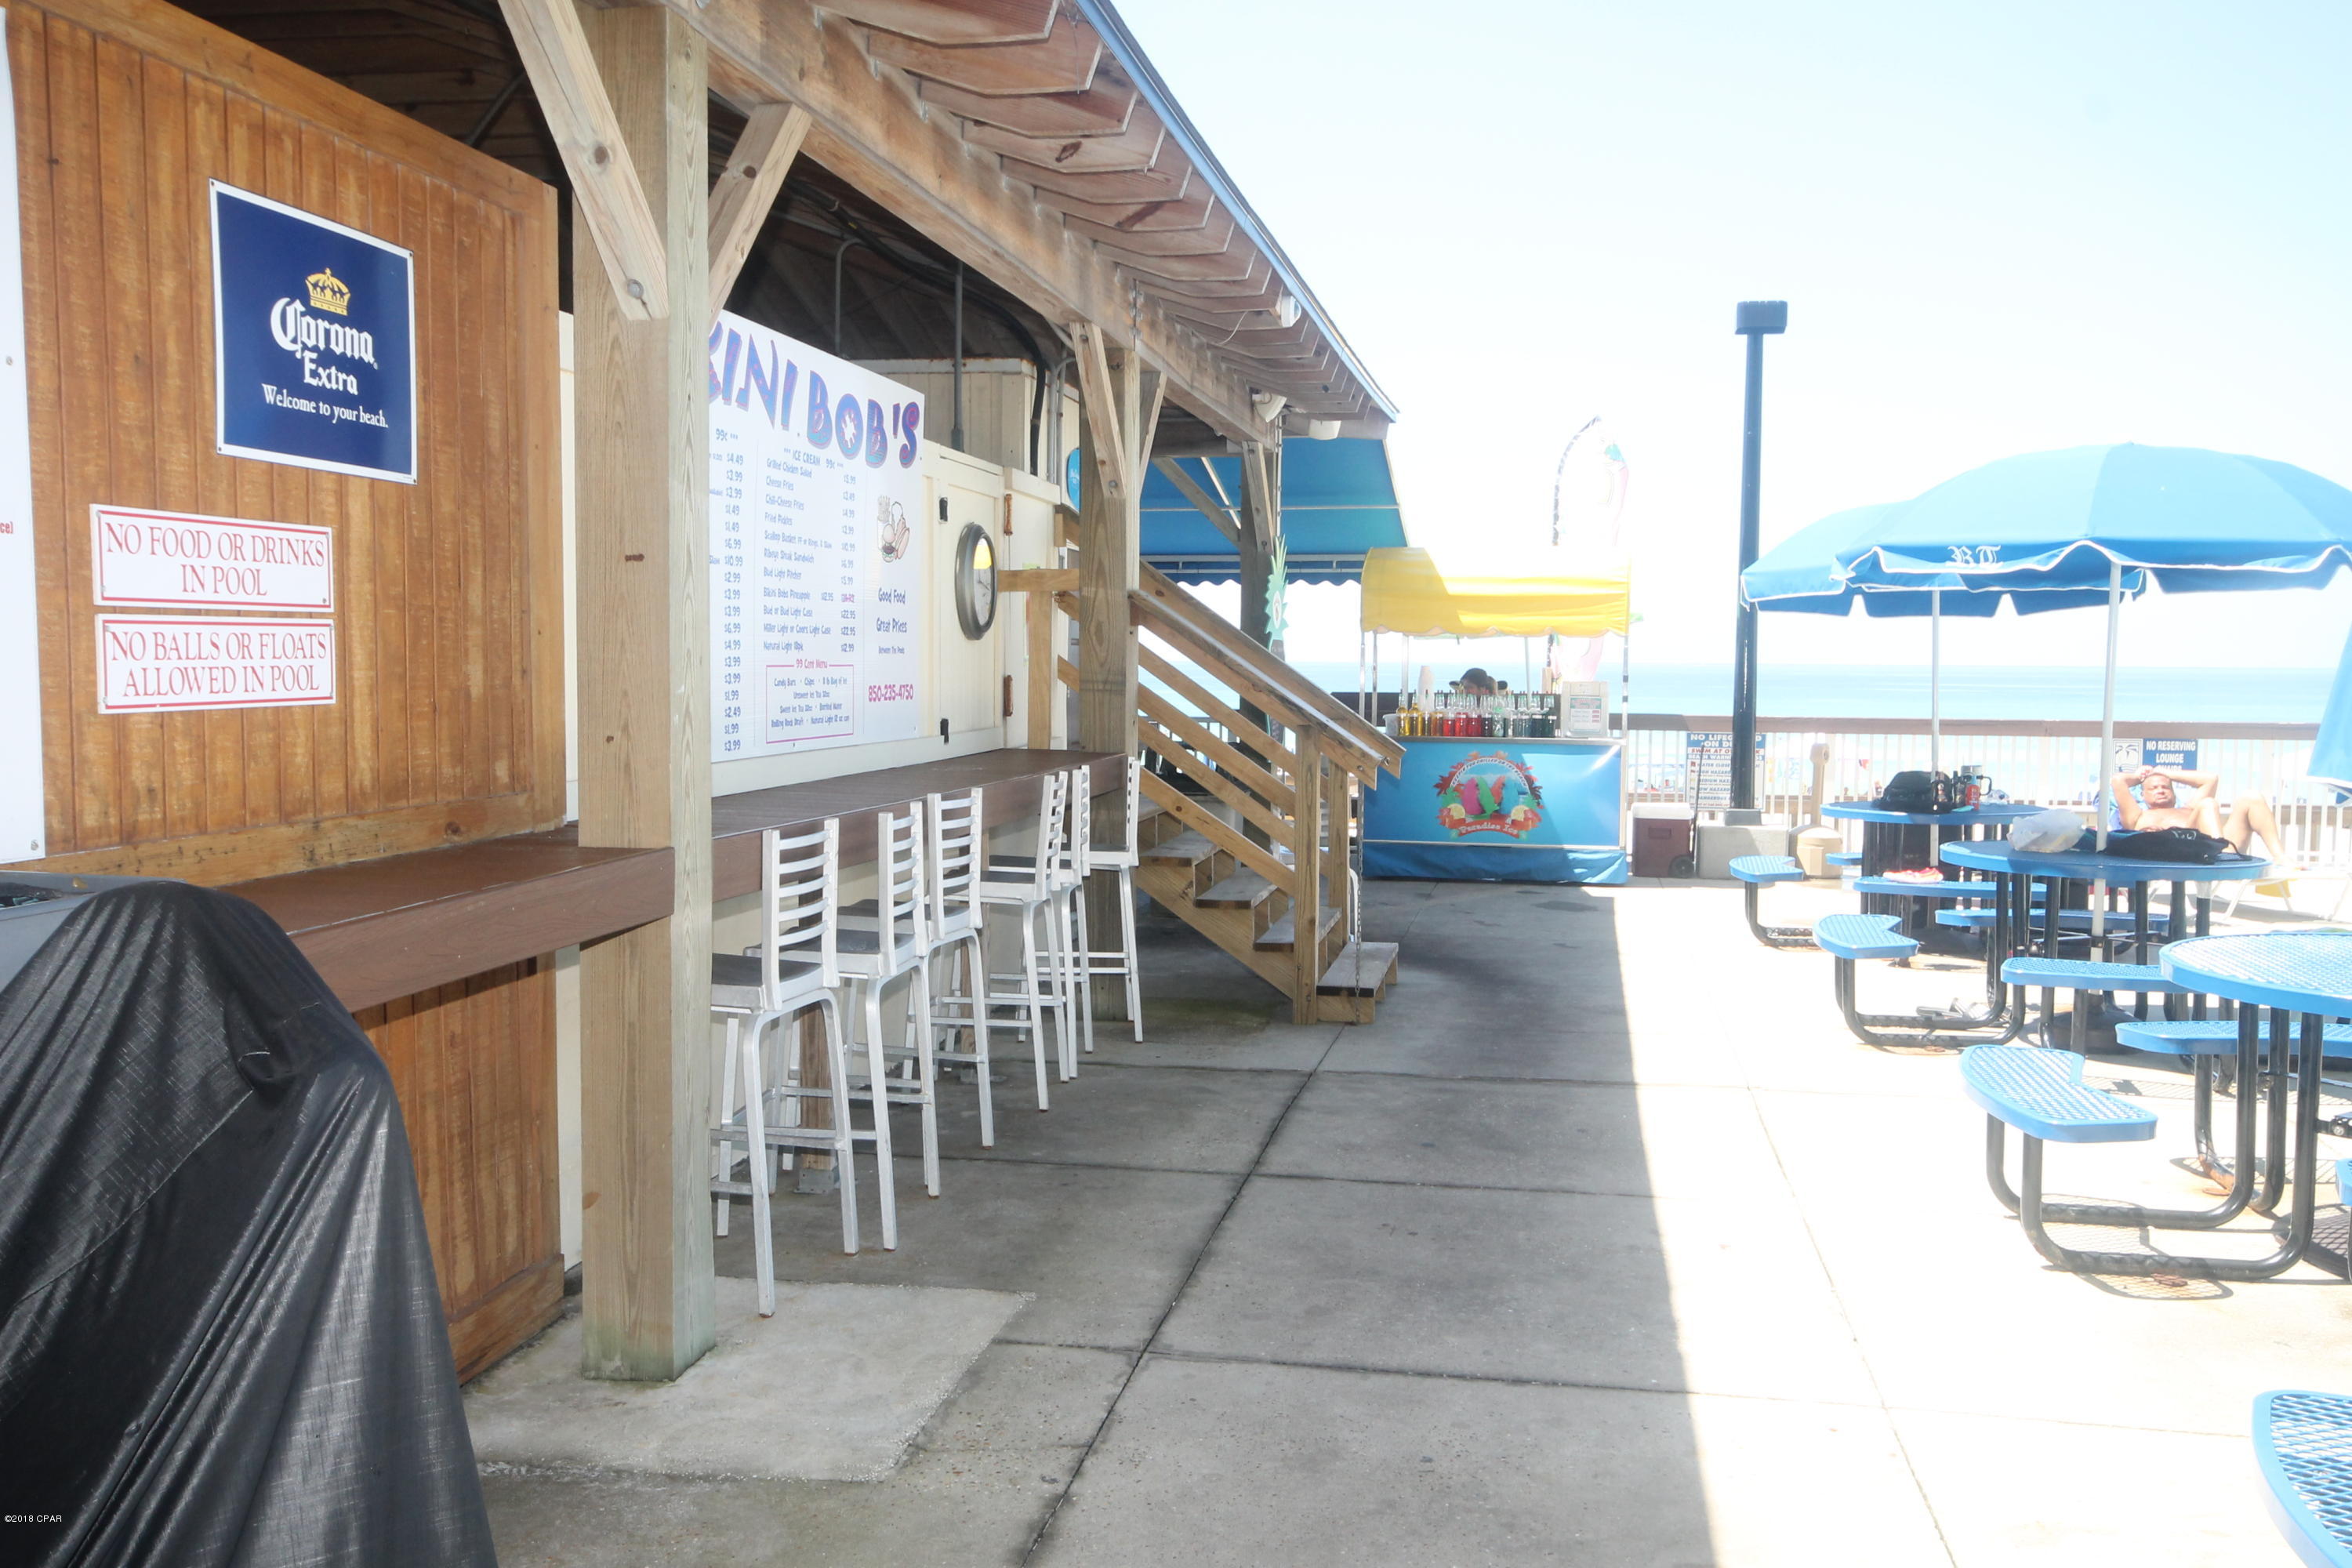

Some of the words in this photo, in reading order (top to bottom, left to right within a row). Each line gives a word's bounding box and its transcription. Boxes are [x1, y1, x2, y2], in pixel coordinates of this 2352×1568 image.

[270, 297, 376, 365] Corona
[303, 350, 358, 396] Extra
[262, 383, 316, 414] Welcome
[318, 401, 331, 416] to
[332, 405, 358, 423] your
[360, 405, 388, 428] beach.
[807, 370, 920, 469] BOB'S
[727, 453, 743, 466] $4.49
[802, 452, 821, 465] CREAM
[782, 462, 799, 474] Chicken
[800, 466, 812, 477] Salad
[726, 470, 742, 483] $3.99
[766, 476, 781, 488] Cheese
[783, 480, 793, 491] Fries
[726, 486, 742, 499] $3.99
[725, 504, 740, 516] $1.49
[793, 499, 804, 510] Fries
[725, 521, 739, 533] $1.49
[105, 522, 142, 555] NO
[149, 526, 212, 559] FOOD
[218, 532, 246, 562] OR
[251, 535, 325, 567] DRINKS
[724, 538, 741, 550] $6.99
[724, 555, 743, 567] $10.99
[794, 552, 814, 564] Sandwich
[724, 572, 741, 583] $2.99
[764, 567, 773, 577] Bud
[775, 568, 785, 581] Light
[181, 564, 205, 593] IN
[212, 565, 267, 597] POOL
[724, 589, 740, 600] $3.99
[878, 587, 892, 604] Good
[894, 589, 906, 604] Food
[724, 605, 740, 617] $3.99
[764, 604, 773, 615] Bud
[780, 606, 789, 616] Bud
[724, 622, 741, 633] $6.99
[877, 617, 891, 633] Great
[892, 618, 907, 633] Prices
[111, 630, 146, 661] NO
[153, 632, 220, 661] BALLS
[226, 632, 254, 660] OR
[259, 633, 327, 659] FLOATS
[724, 639, 741, 651] $4.99
[724, 656, 741, 667] $3.99
[797, 659, 803, 669] 99
[804, 659, 814, 669] Cent
[815, 659, 828, 669] Menu
[123, 666, 236, 697] ALLOWED
[243, 666, 265, 693] IN
[270, 664, 320, 691] POOL
[724, 673, 741, 684] $3.99
[724, 690, 739, 701] $1.99
[868, 684, 914, 702] 850-235-4750
[724, 706, 741, 717] $2.49
[724, 723, 739, 734] $1.99
[724, 739, 741, 752] $3.99
[2146, 740, 2156, 750] NO
[2158, 741, 2196, 751] RESERVING
[2156, 753, 2184, 763] LOUNGE
[1459, 822, 1501, 833] Paradise
